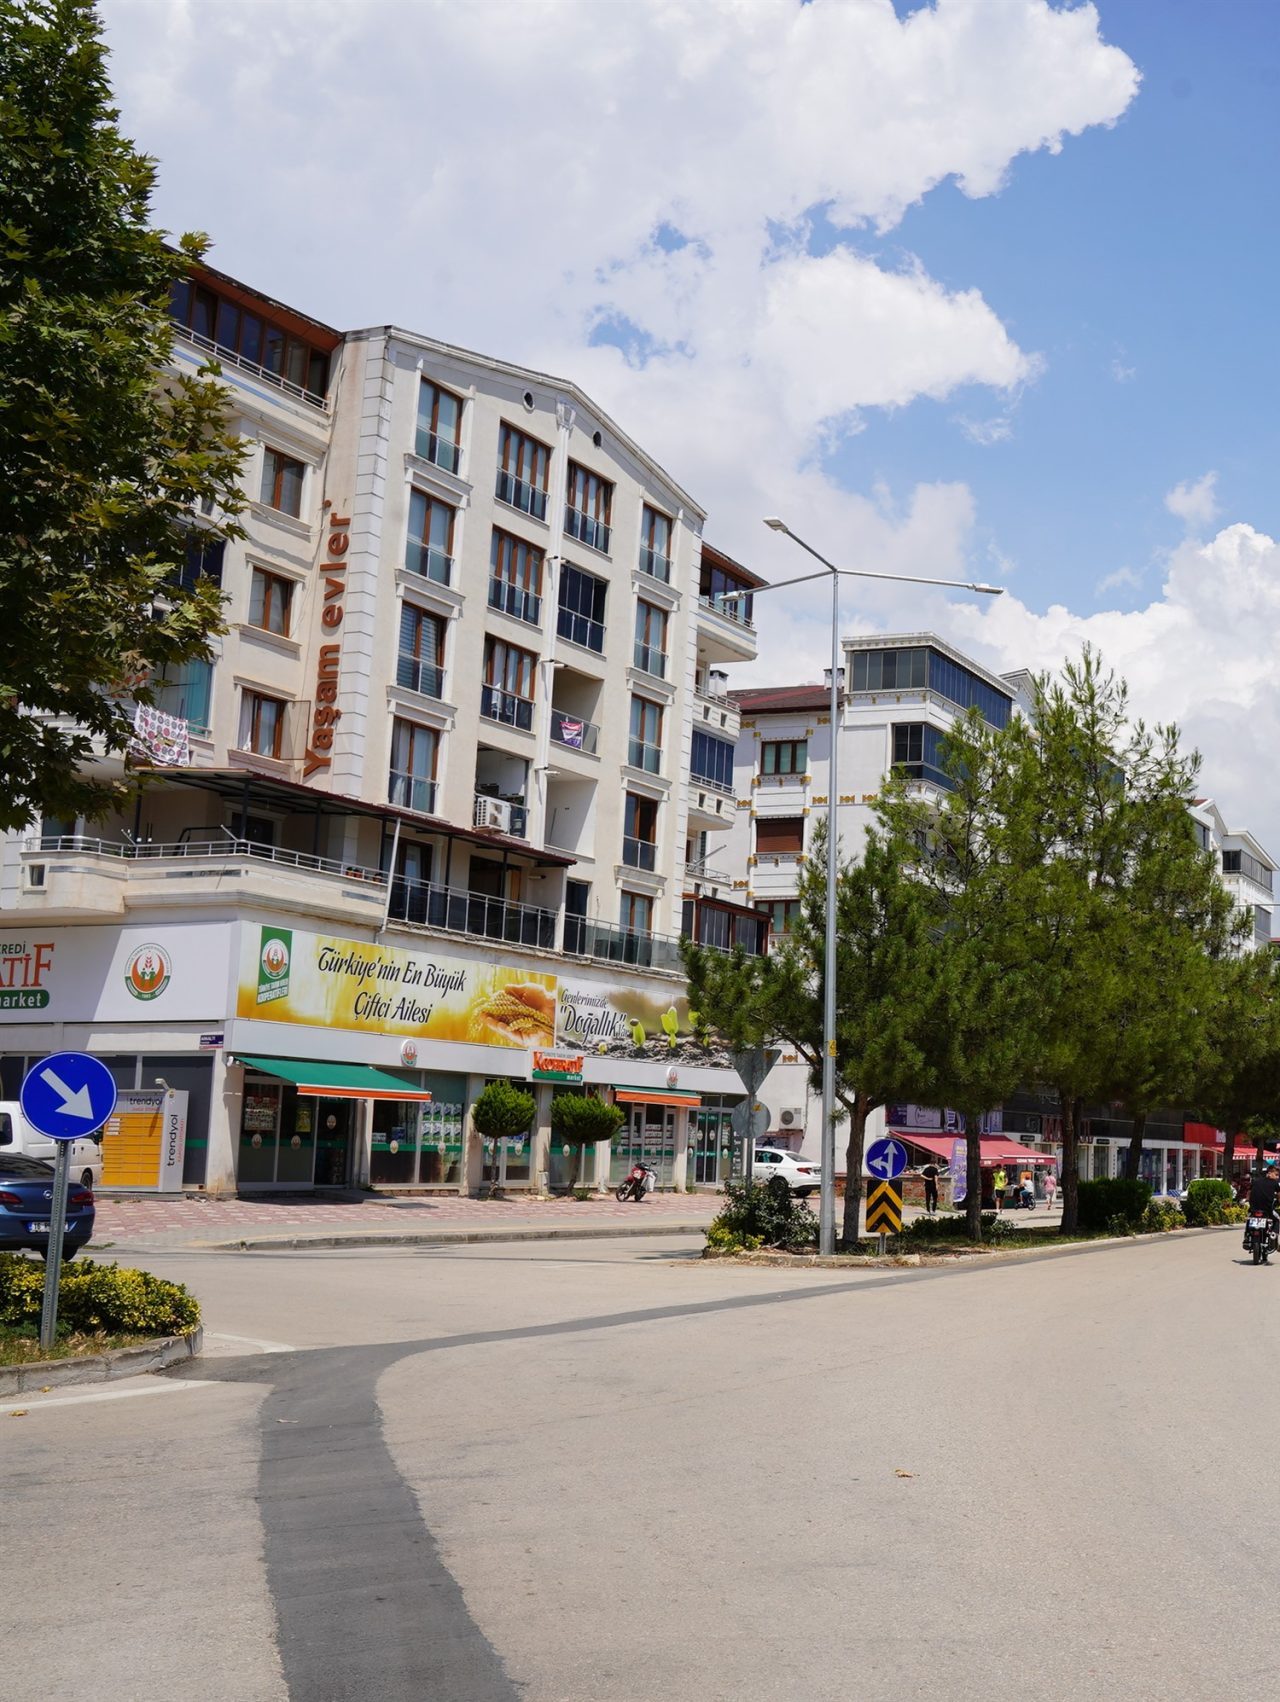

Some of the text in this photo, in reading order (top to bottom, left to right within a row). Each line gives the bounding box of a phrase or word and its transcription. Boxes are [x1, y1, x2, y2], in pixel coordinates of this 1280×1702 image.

[0, 941, 26, 954] REDİ
[318, 947, 467, 999] Türkiye'nin En Büyük
[0, 992, 41, 1007] arket
[354, 991, 433, 1023] Çiftçi Ailesi
[129, 1098, 163, 1106] trendyol
[167, 1114, 178, 1167] trendyol
